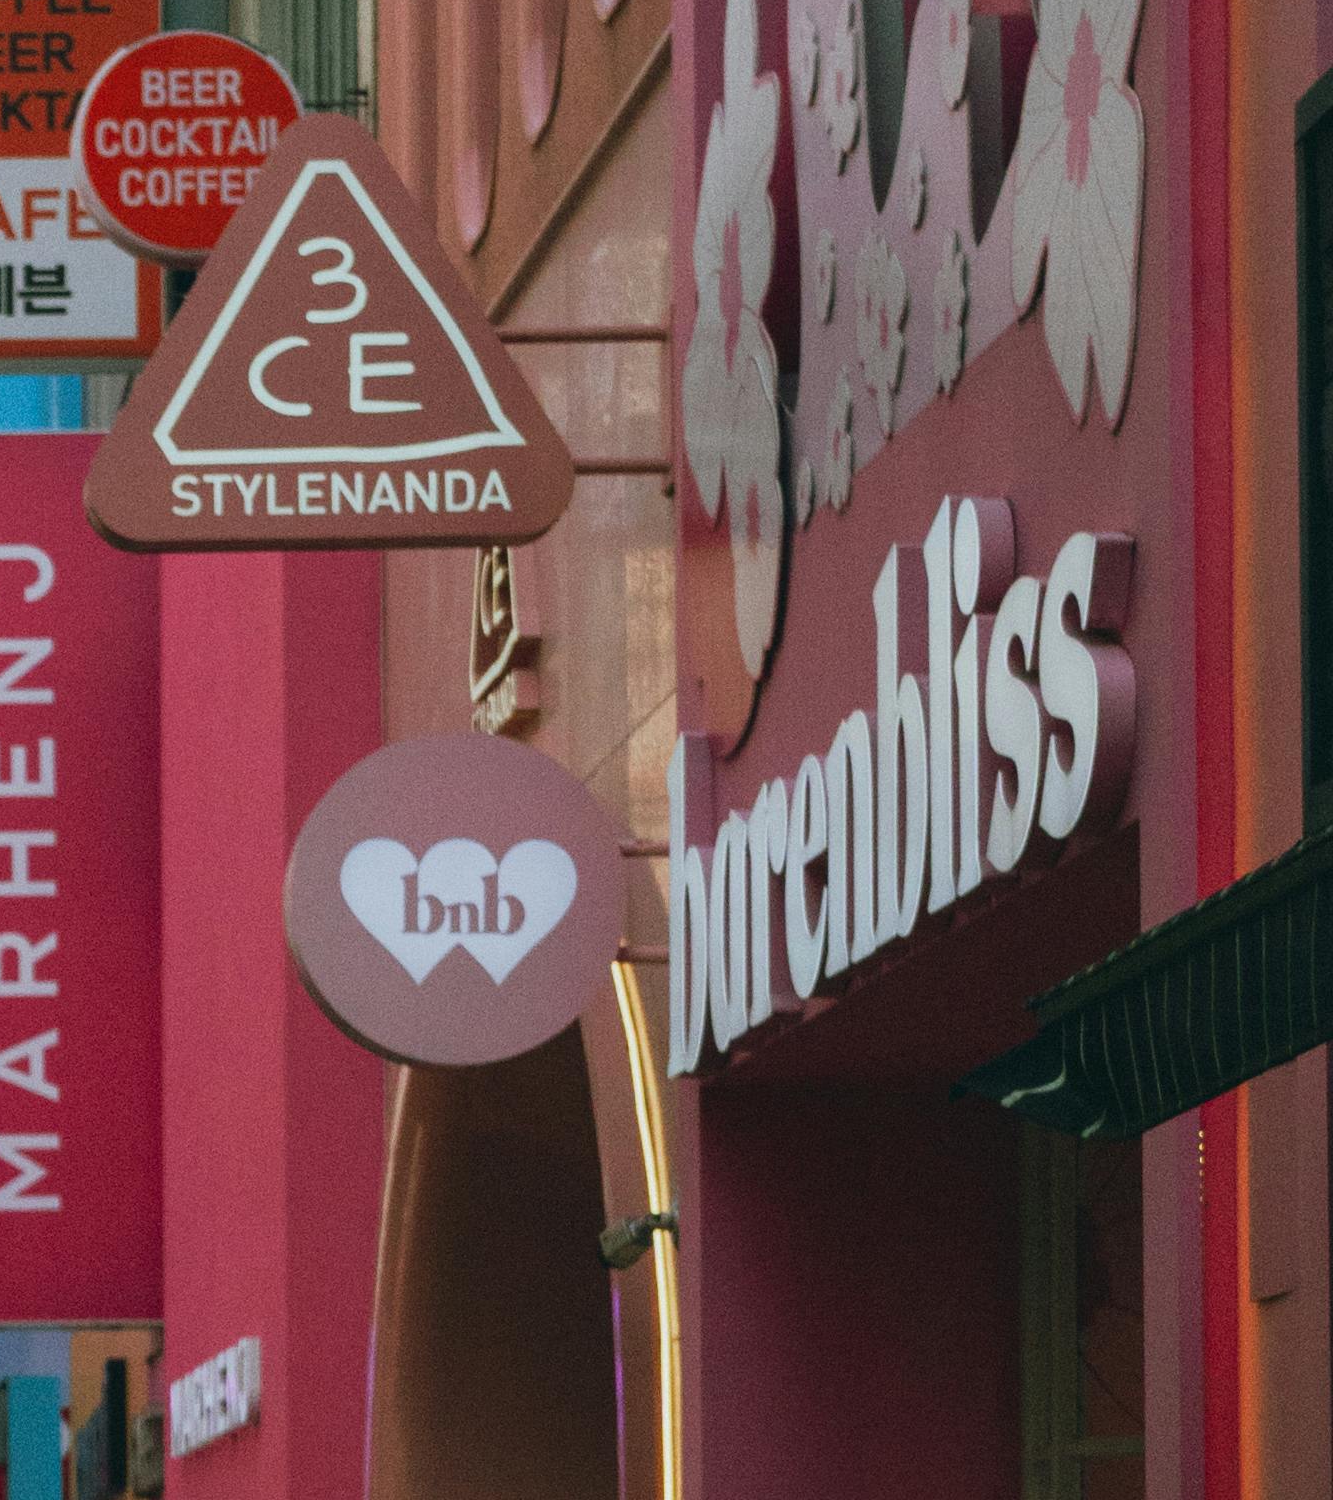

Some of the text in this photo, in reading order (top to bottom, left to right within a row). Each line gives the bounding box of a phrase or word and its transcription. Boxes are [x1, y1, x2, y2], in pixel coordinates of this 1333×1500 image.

[140, 67, 244, 107] BEER
[170, 469, 513, 518] STYLENANDA
[668, 495, 1100, 1078] barenbliss
[401, 873, 526, 937] bnb
